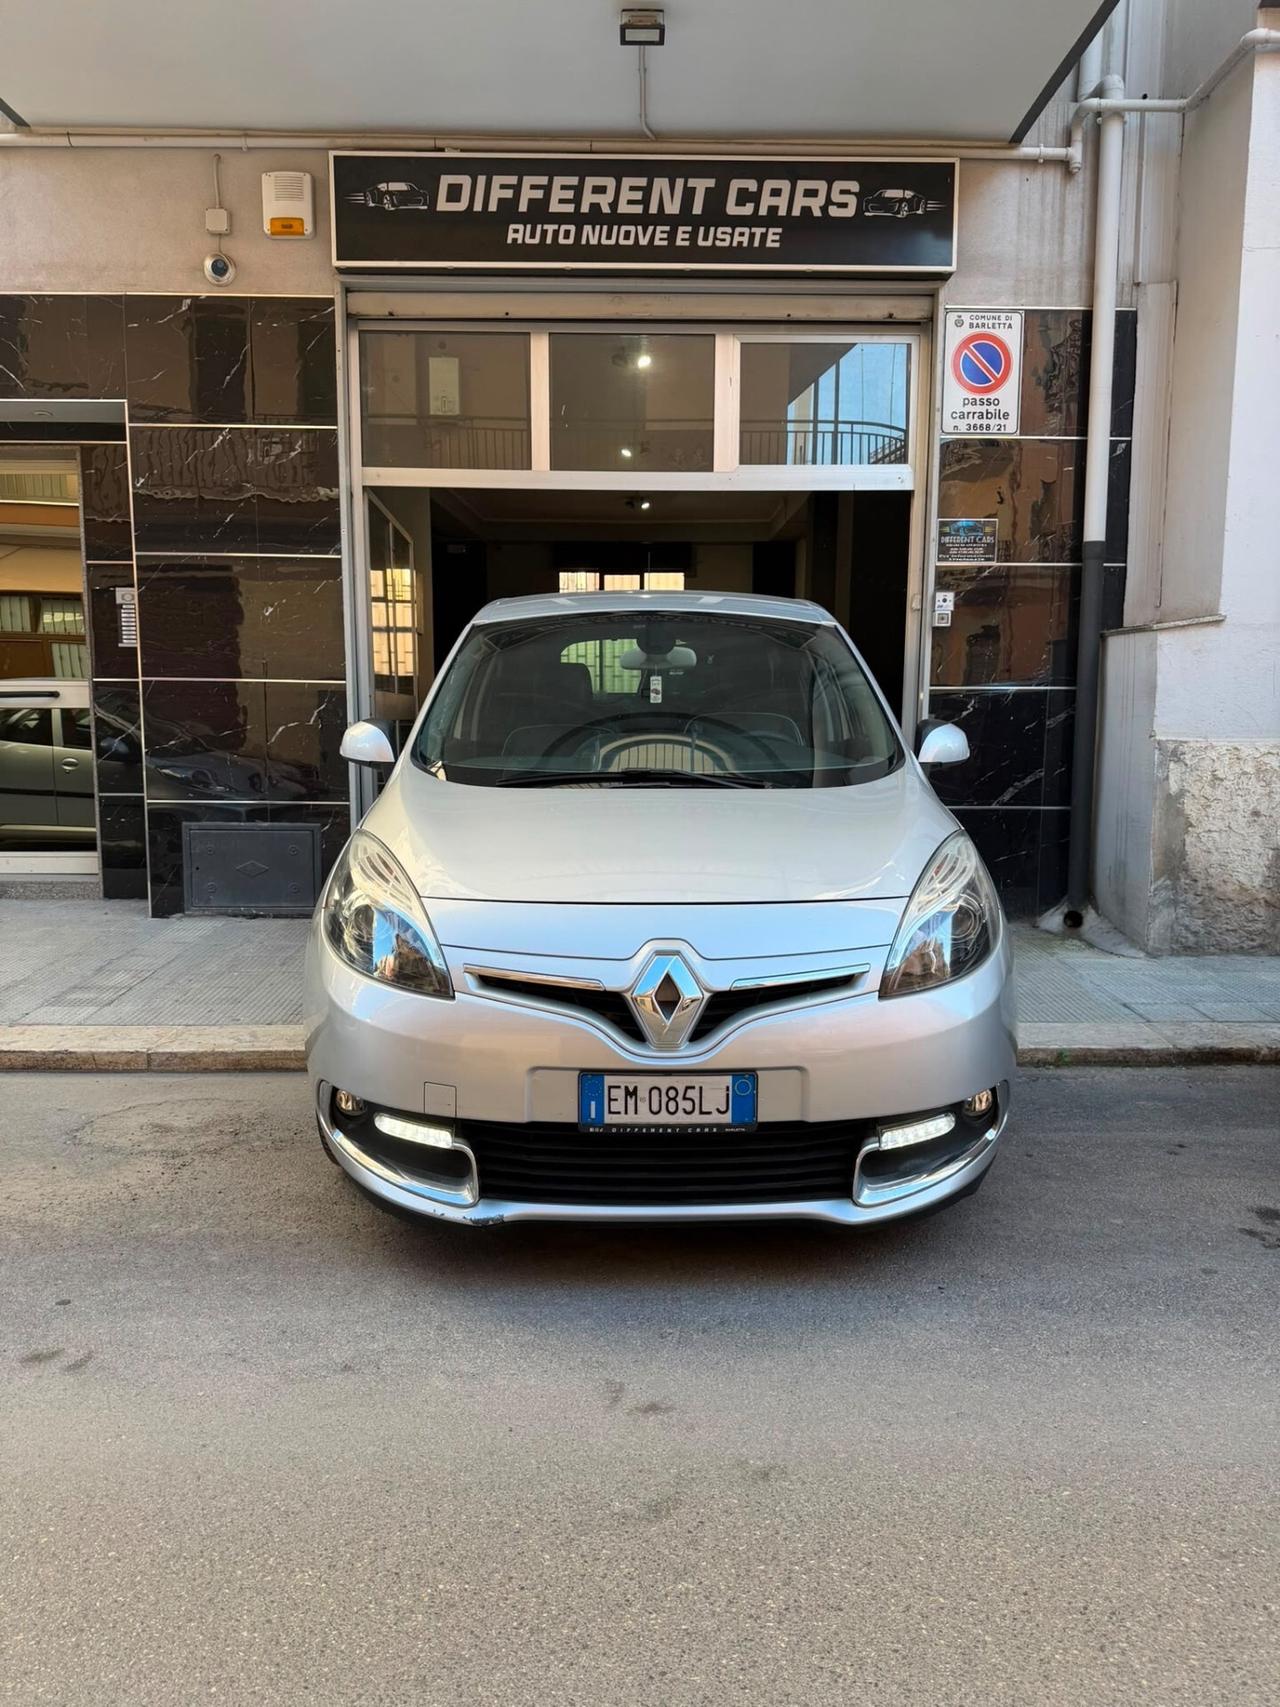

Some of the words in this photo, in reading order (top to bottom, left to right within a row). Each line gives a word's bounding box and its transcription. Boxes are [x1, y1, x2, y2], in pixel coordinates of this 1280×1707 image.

[436, 174, 717, 214] DIFFERENT
[725, 178, 861, 218] CARS
[506, 223, 577, 245] AUTO
[580, 224, 671, 247] NUOVE
[675, 226, 693, 247] E
[697, 226, 783, 248] USATE
[962, 397, 1000, 408] passo
[950, 409, 1010, 420] carrabile
[965, 423, 1007, 432] 3668/21
[607, 1085, 638, 1115] EM
[648, 1085, 730, 1116] 085LJ
